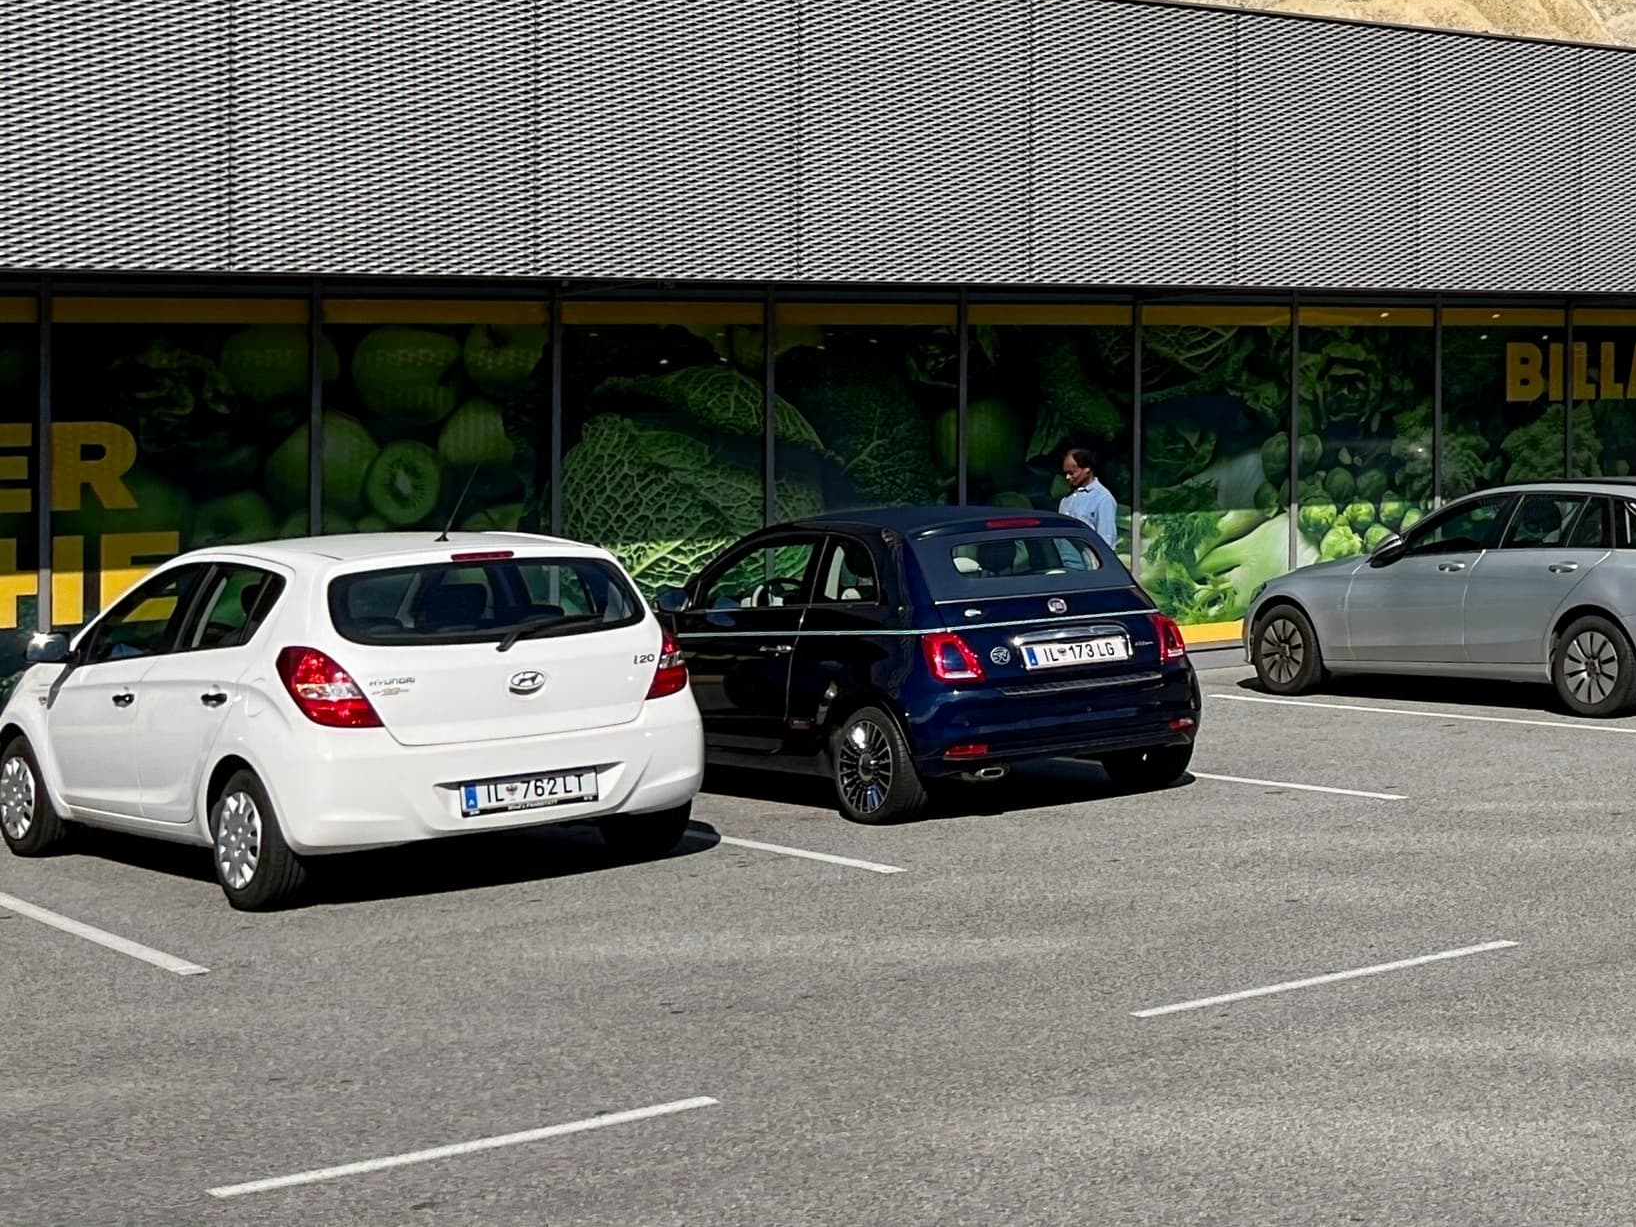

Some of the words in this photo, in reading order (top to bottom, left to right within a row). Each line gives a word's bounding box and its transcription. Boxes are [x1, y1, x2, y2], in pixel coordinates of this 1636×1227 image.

[1043, 647, 1059, 662] IL
[1068, 643, 1095, 659] 173
[1096, 642, 1115, 657] LG
[487, 782, 505, 803] IL
[521, 776, 559, 799] 762
[562, 774, 584, 793] LT
